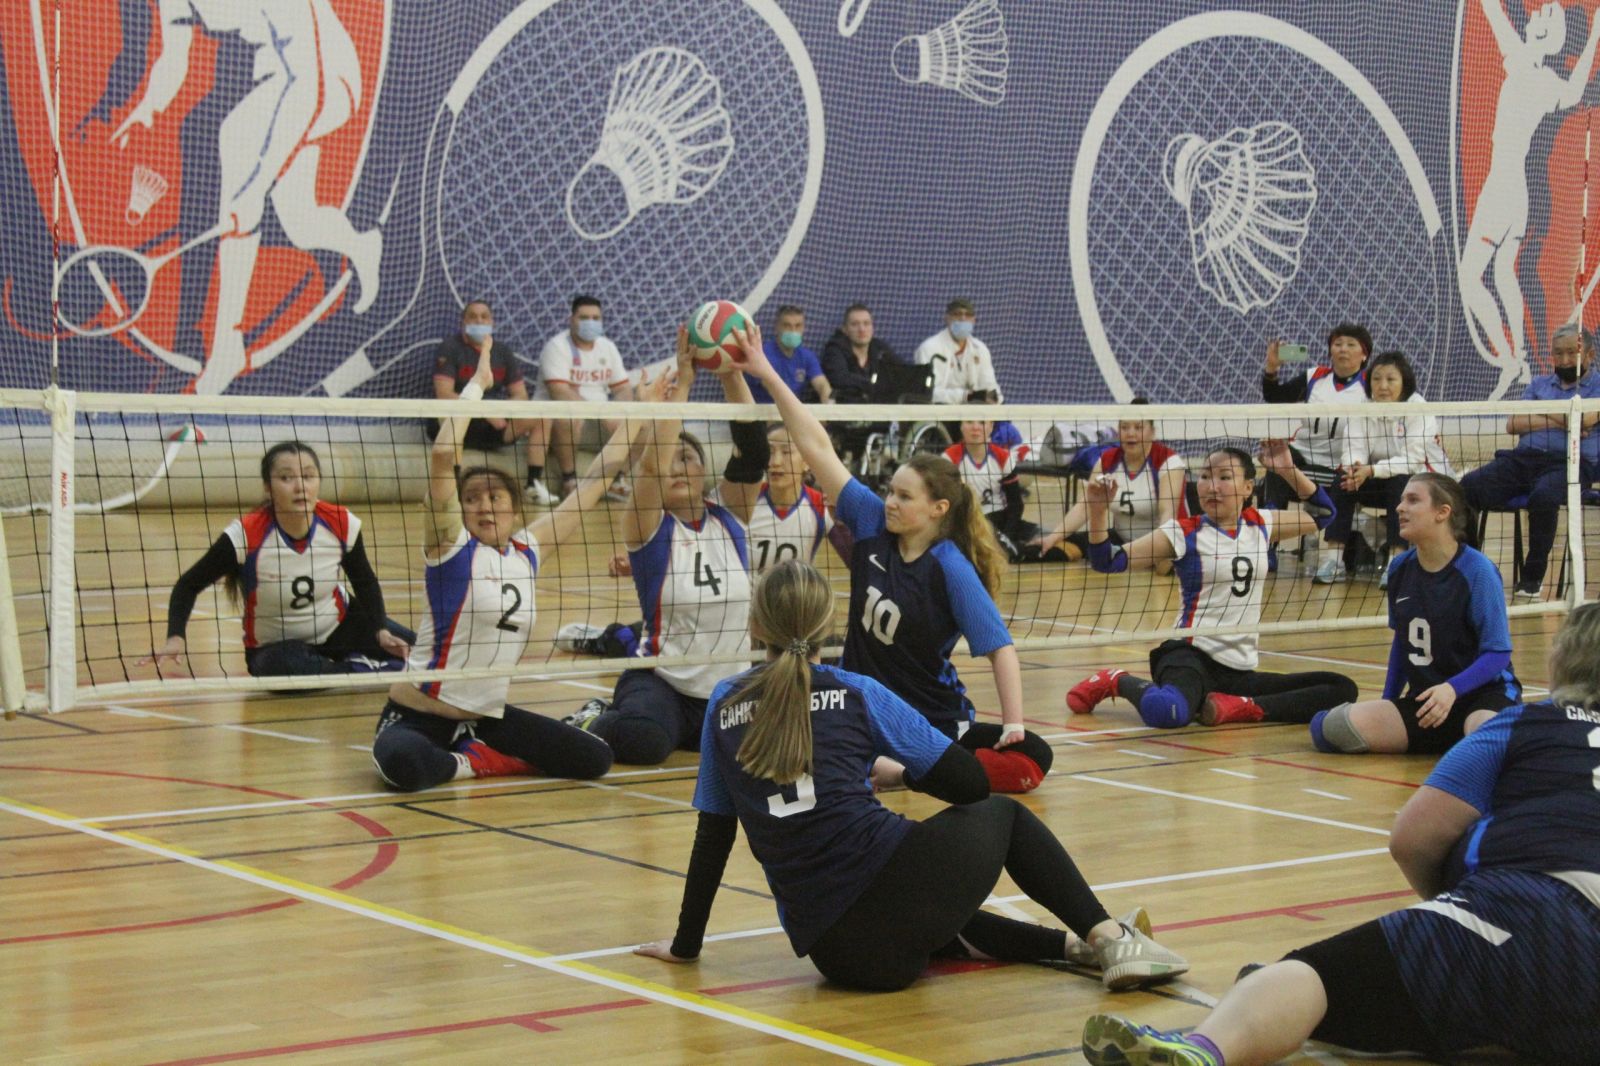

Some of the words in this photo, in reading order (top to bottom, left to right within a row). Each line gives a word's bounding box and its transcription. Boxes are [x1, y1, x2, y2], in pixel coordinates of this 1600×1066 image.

[1119, 491, 1135, 517] 5
[289, 575, 315, 610] 8
[693, 551, 722, 596] 4
[1230, 556, 1254, 598] 9
[495, 583, 522, 632] 2
[861, 585, 902, 646] 10
[1408, 617, 1434, 666] 9
